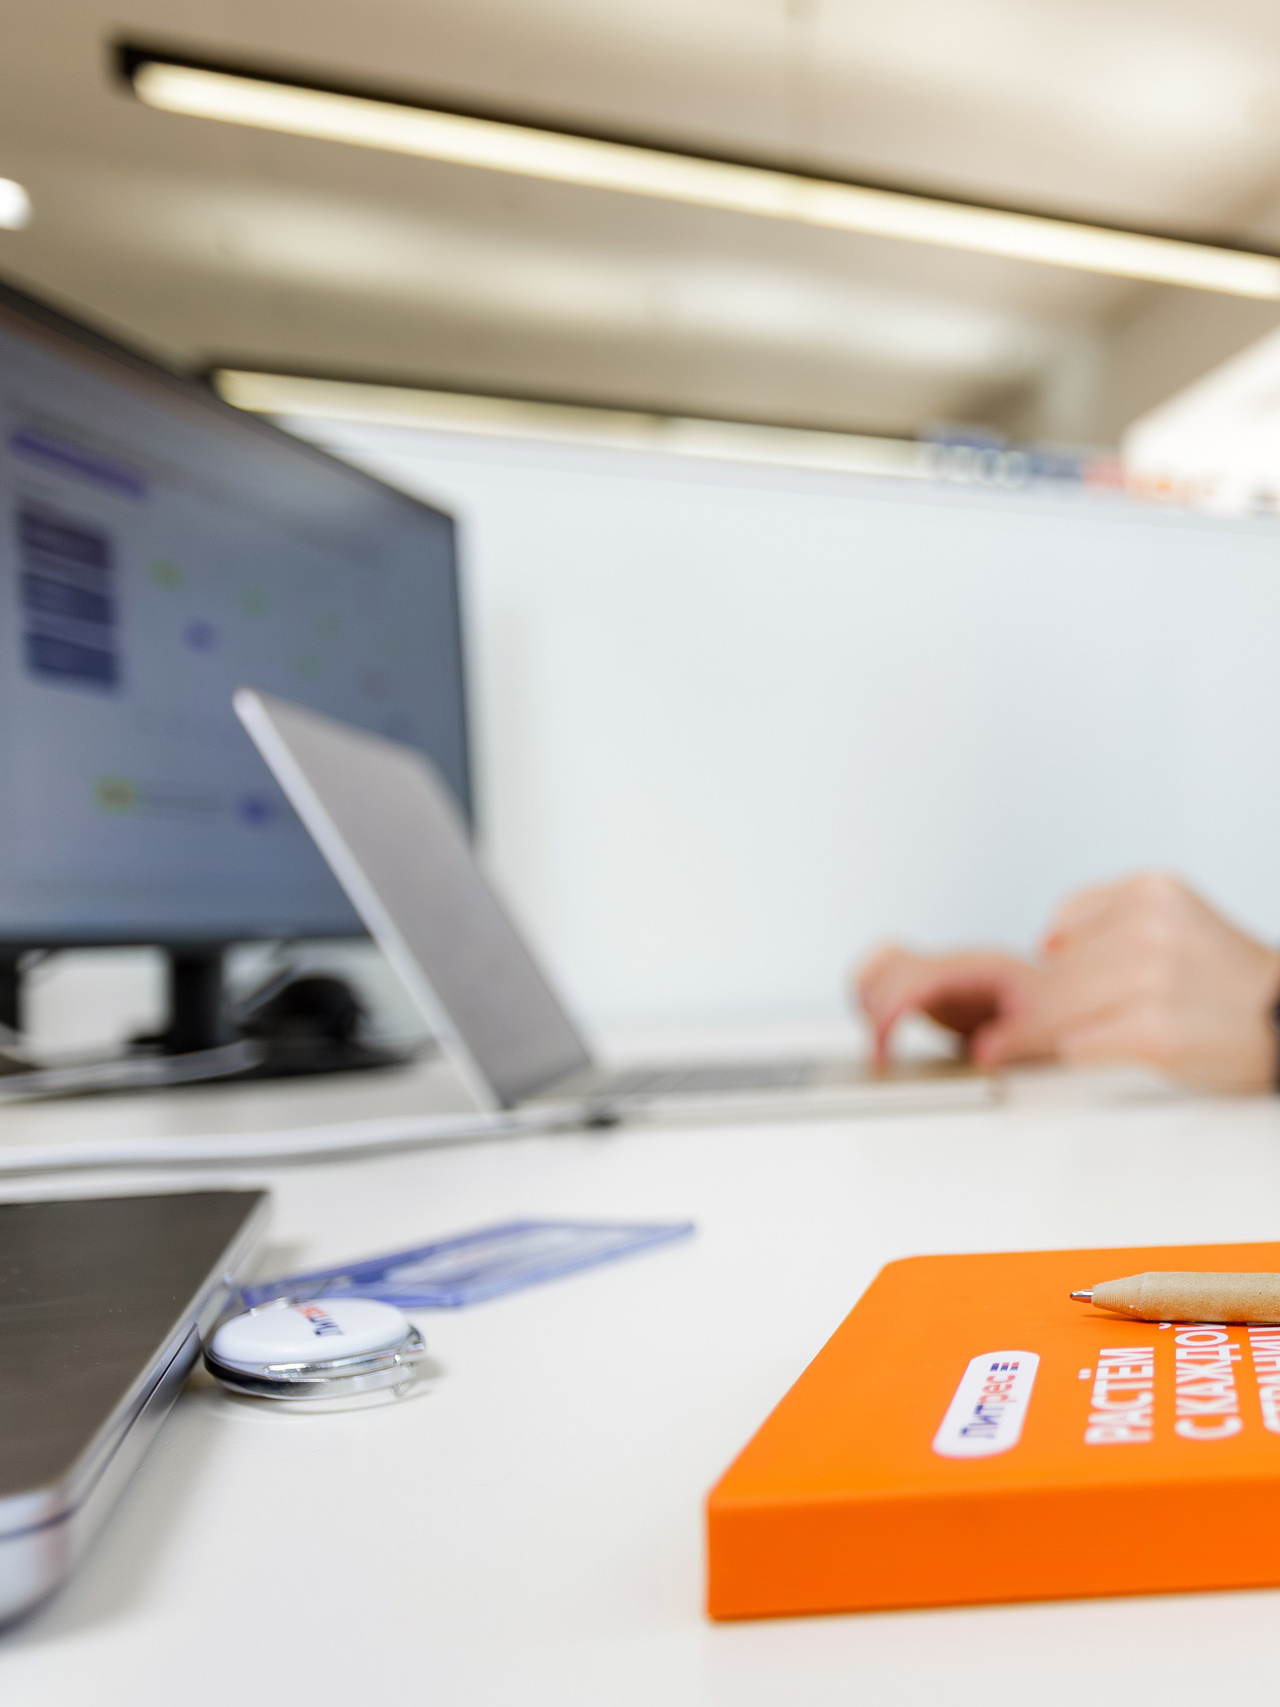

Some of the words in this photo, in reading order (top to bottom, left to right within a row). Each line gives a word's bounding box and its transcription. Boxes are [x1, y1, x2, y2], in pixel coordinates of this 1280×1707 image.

[959, 1375, 1017, 1439] Литрес
[1078, 1347, 1155, 1445] РАСТЁМ
[1174, 1415, 1243, 1442] С
